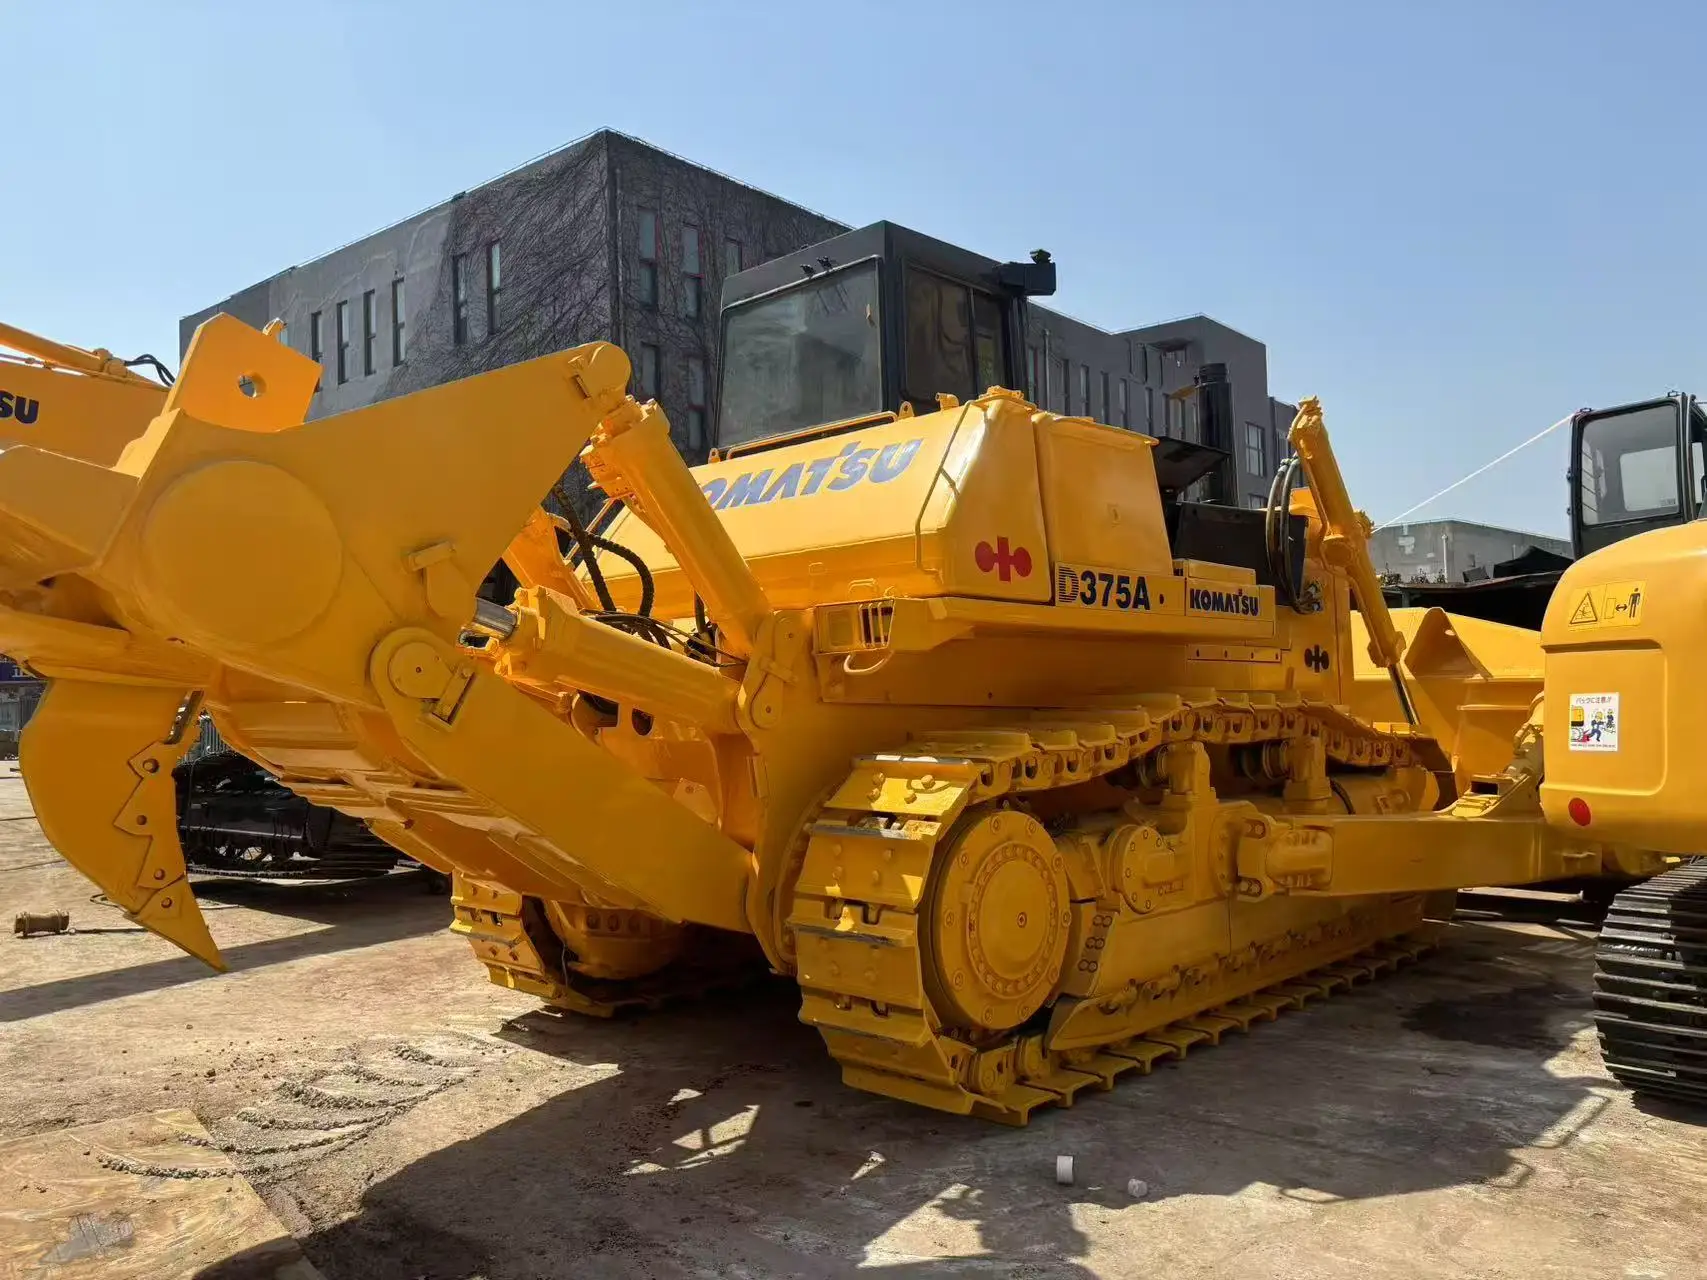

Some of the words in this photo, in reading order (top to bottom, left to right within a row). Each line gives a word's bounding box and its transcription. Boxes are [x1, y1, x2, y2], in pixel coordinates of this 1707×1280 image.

[701, 438, 924, 510] OMATSU
[1059, 566, 1150, 610] D375A
[1190, 588, 1259, 616] KOMATSU
